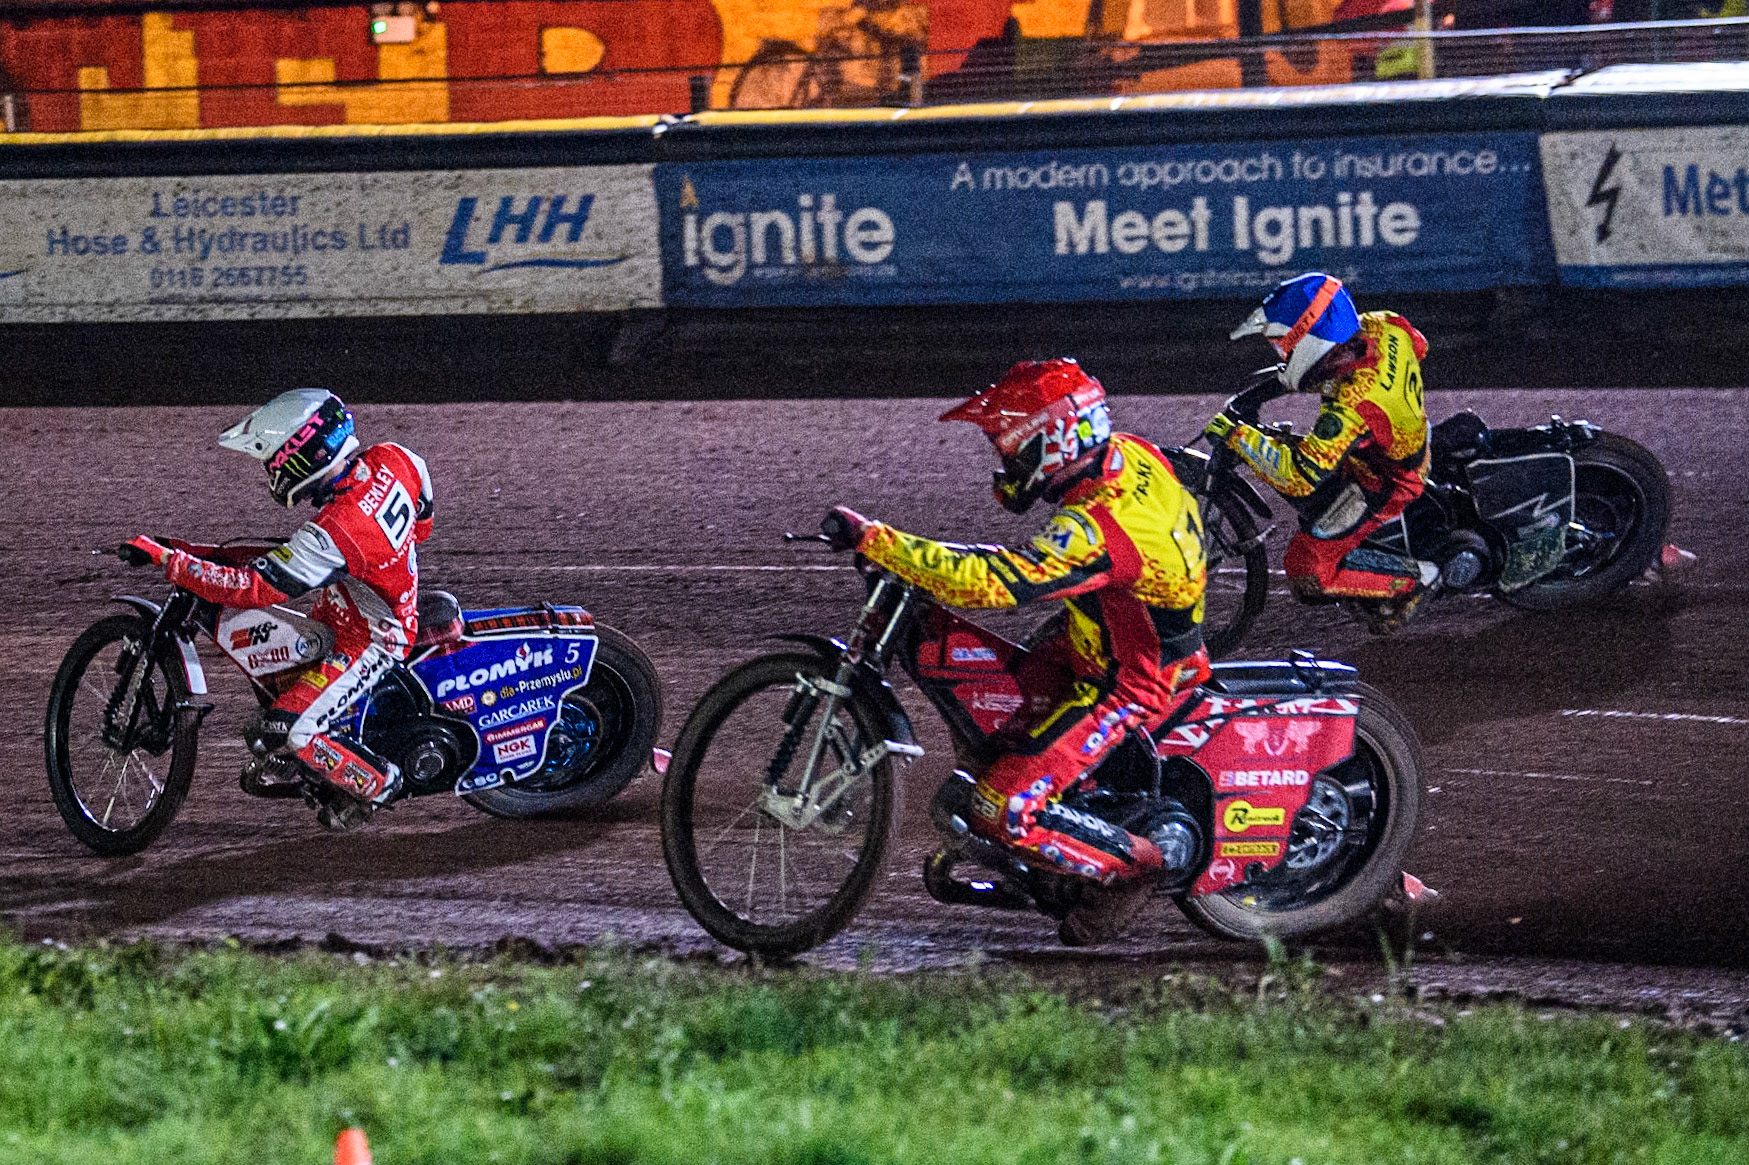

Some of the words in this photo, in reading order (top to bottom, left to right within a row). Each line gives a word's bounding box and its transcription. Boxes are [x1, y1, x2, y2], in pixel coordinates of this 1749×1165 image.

[951, 162, 975, 190] A
[982, 161, 1110, 190] modern
[1118, 152, 1283, 190] approach
[1292, 151, 1326, 180] to
[150, 191, 300, 218] Leicester
[48, 229, 129, 255] Hose
[141, 226, 161, 253] &
[174, 223, 347, 260] Hydraulics
[357, 222, 411, 251] Ltd
[440, 195, 595, 264] LHH
[1053, 197, 1212, 255] Meet
[1234, 191, 1420, 265] Ignite
[1380, 334, 1399, 392] LAWSON
[382, 491, 410, 541] 5
[564, 642, 581, 664] 5
[478, 695, 556, 727] GARCAREK
[497, 739, 531, 756] NGK
[1235, 769, 1309, 786] BETARD
